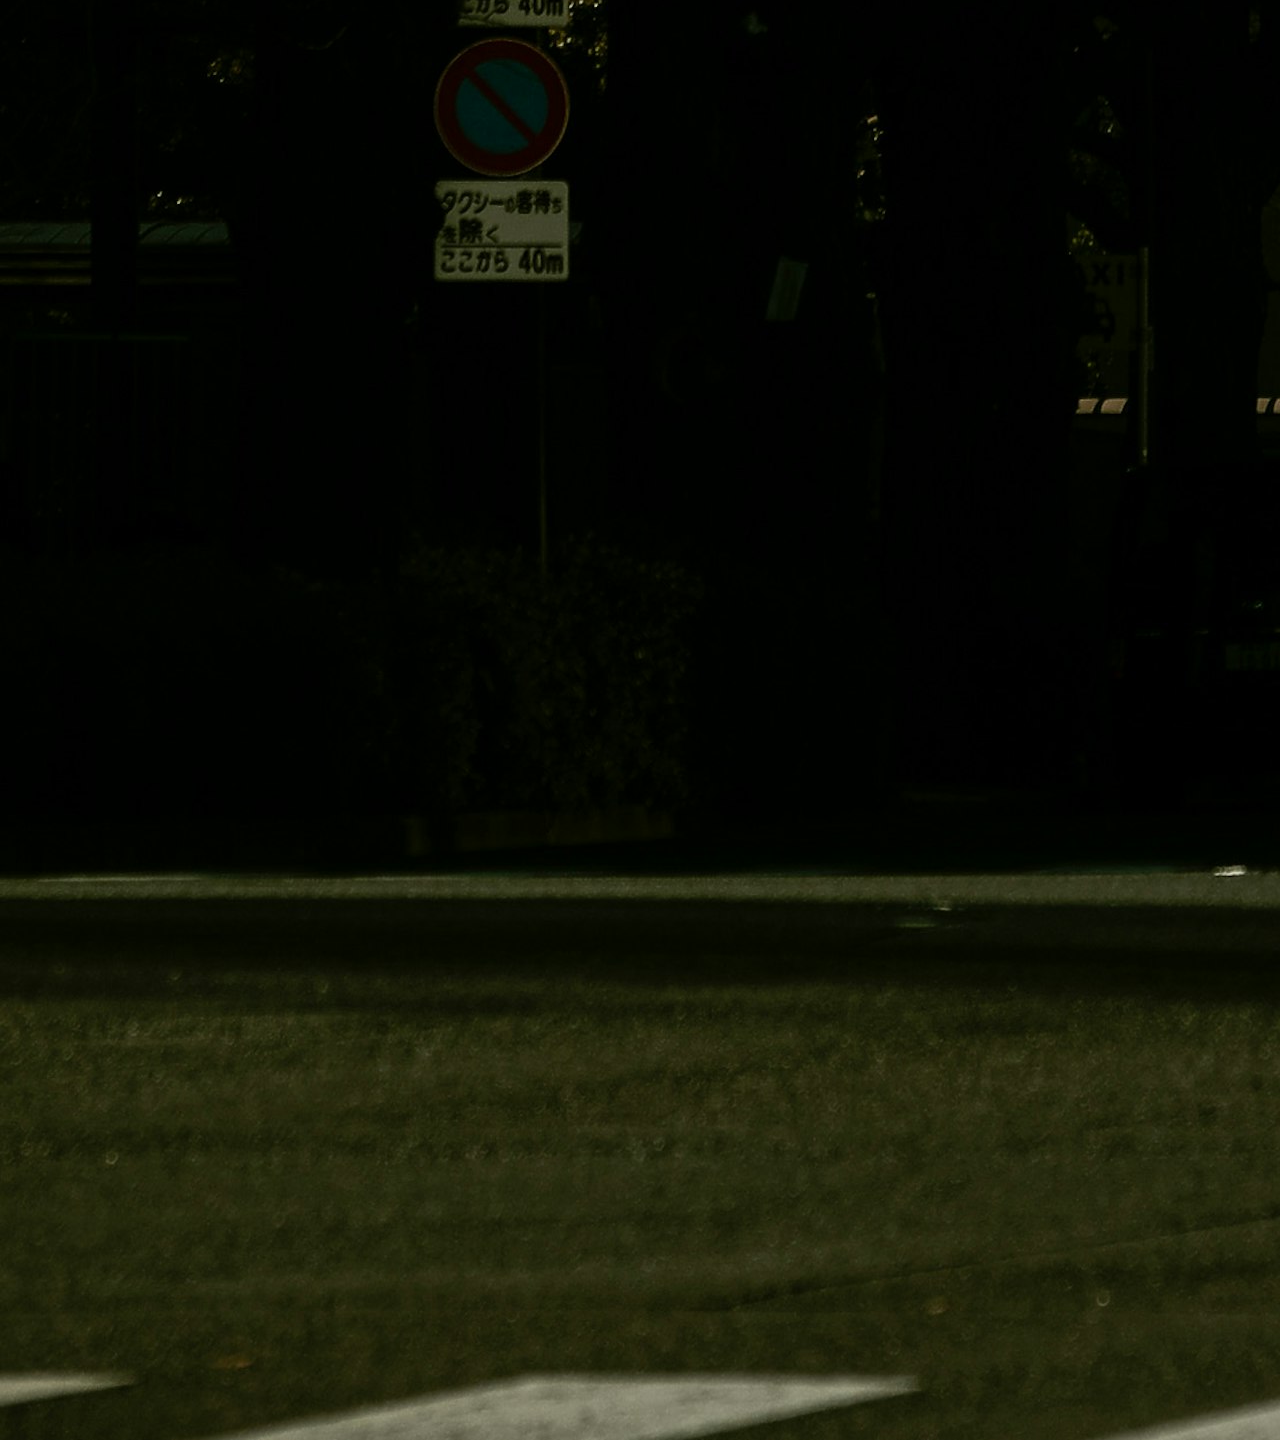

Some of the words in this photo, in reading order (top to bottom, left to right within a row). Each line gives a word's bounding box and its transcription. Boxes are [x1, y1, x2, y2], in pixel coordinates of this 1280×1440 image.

[441, 190, 562, 215] タクシーの客待ち
[442, 218, 499, 245] を除く
[441, 250, 509, 274] ここから
[519, 249, 564, 275] 40m
